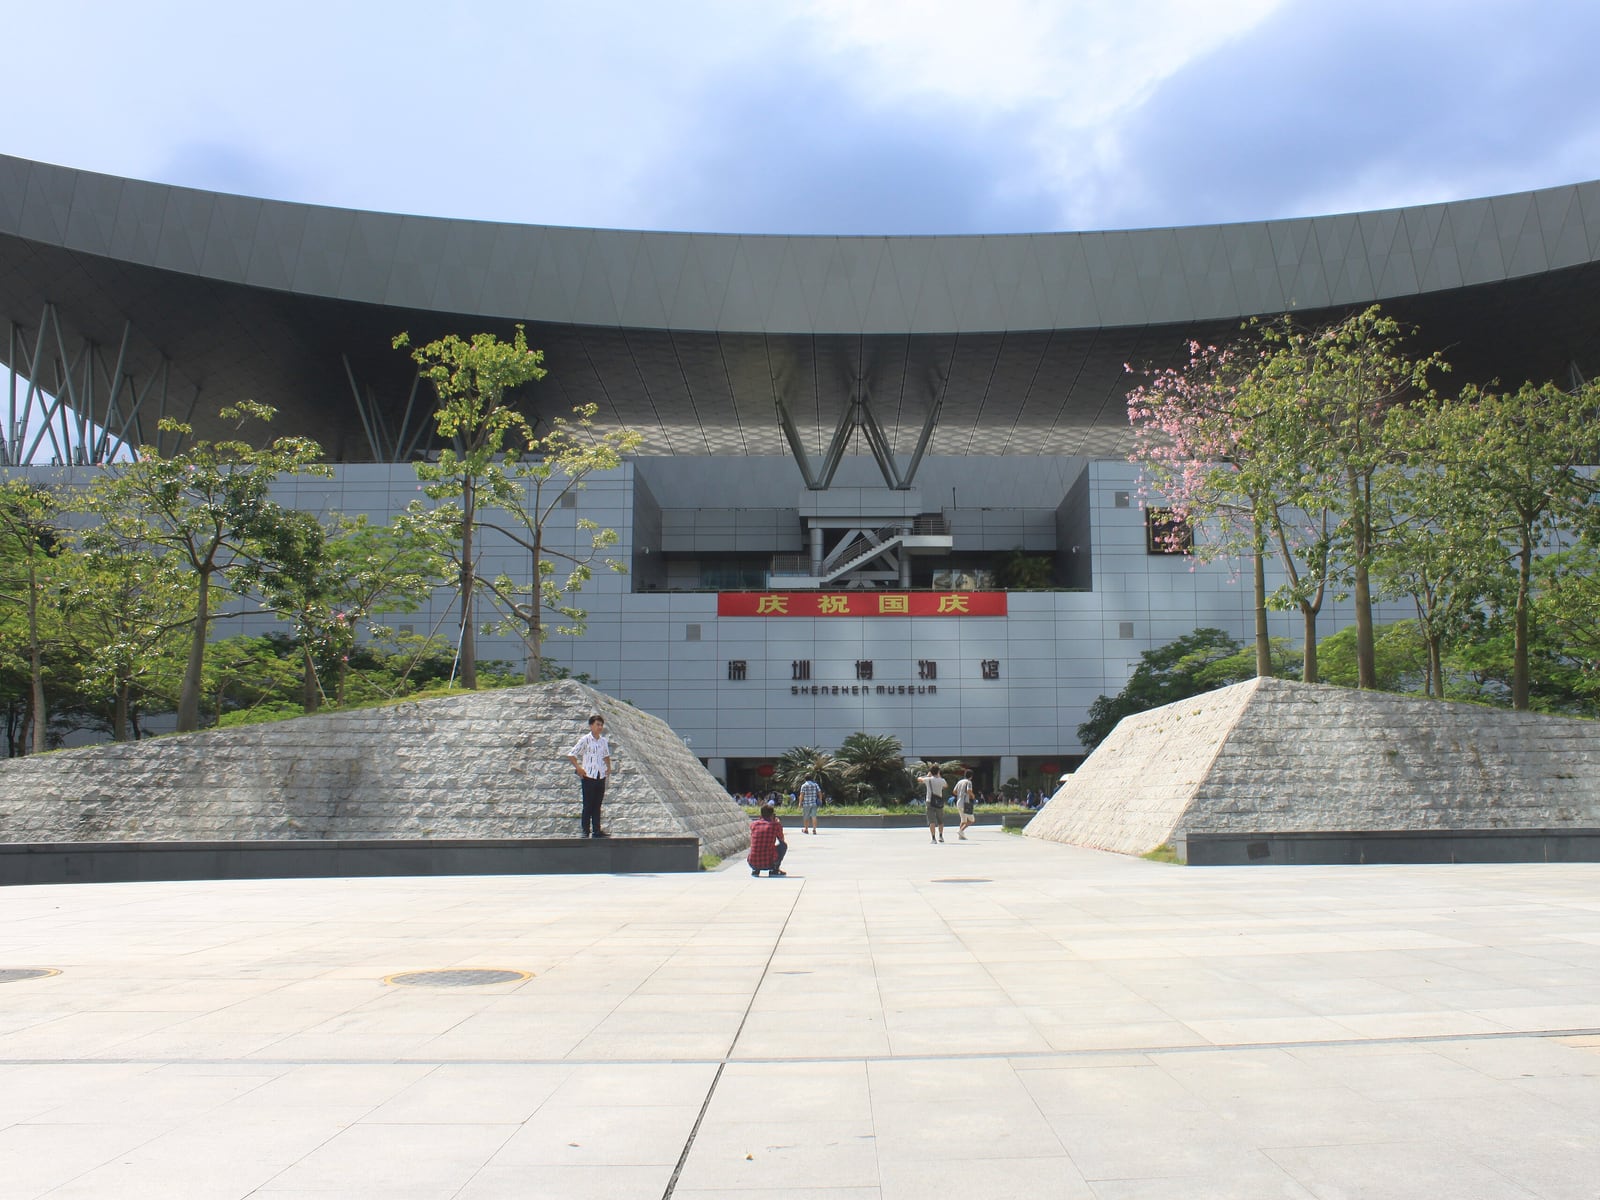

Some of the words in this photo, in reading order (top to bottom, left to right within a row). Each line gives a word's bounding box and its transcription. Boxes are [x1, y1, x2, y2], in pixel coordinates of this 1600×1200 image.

[756, 595, 970, 614] 庆祝国庆
[728, 659, 1000, 681] 深圳博物馆
[791, 685, 869, 696] SHENZHEN
[876, 685, 937, 695] MUSEUM
